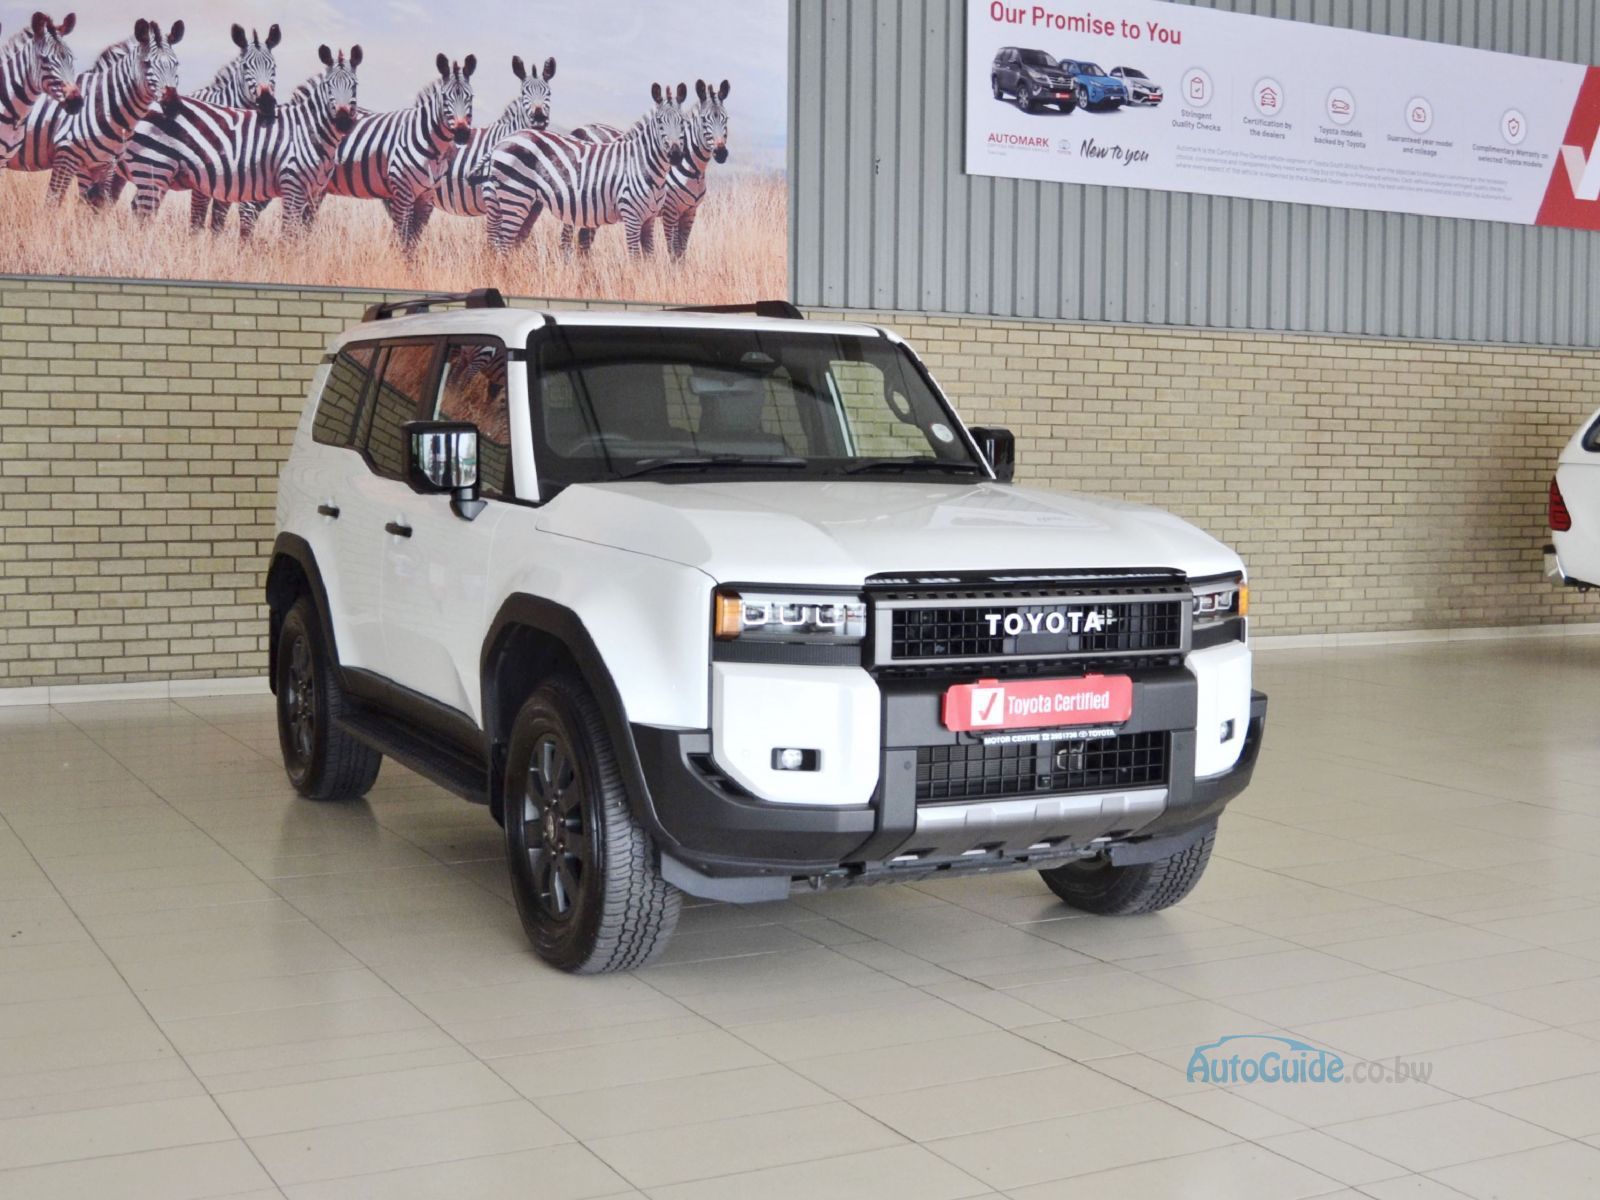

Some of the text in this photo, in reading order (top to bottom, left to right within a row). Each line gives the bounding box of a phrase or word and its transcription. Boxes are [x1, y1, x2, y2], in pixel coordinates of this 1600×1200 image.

[990, 1, 1182, 45] Our Promise to You
[1181, 109, 1212, 120] Stringent
[1171, 120, 1221, 132] Quality Checks
[1242, 116, 1292, 130] Certification by
[1250, 128, 1285, 140] the dealers
[1319, 126, 1339, 136] Toyota
[988, 133, 1049, 148] AUTOMARK
[1346, 140, 1366, 149] Toyota
[1080, 138, 1109, 158] New
[1123, 149, 1149, 166] you
[985, 611, 1102, 636] TOYOTA
[1008, 690, 1110, 716] Toyota Certified
[984, 735, 1011, 745] MOTOR
[1012, 734, 1040, 743] CENTRE
[1088, 729, 1115, 737] TOYOTA
